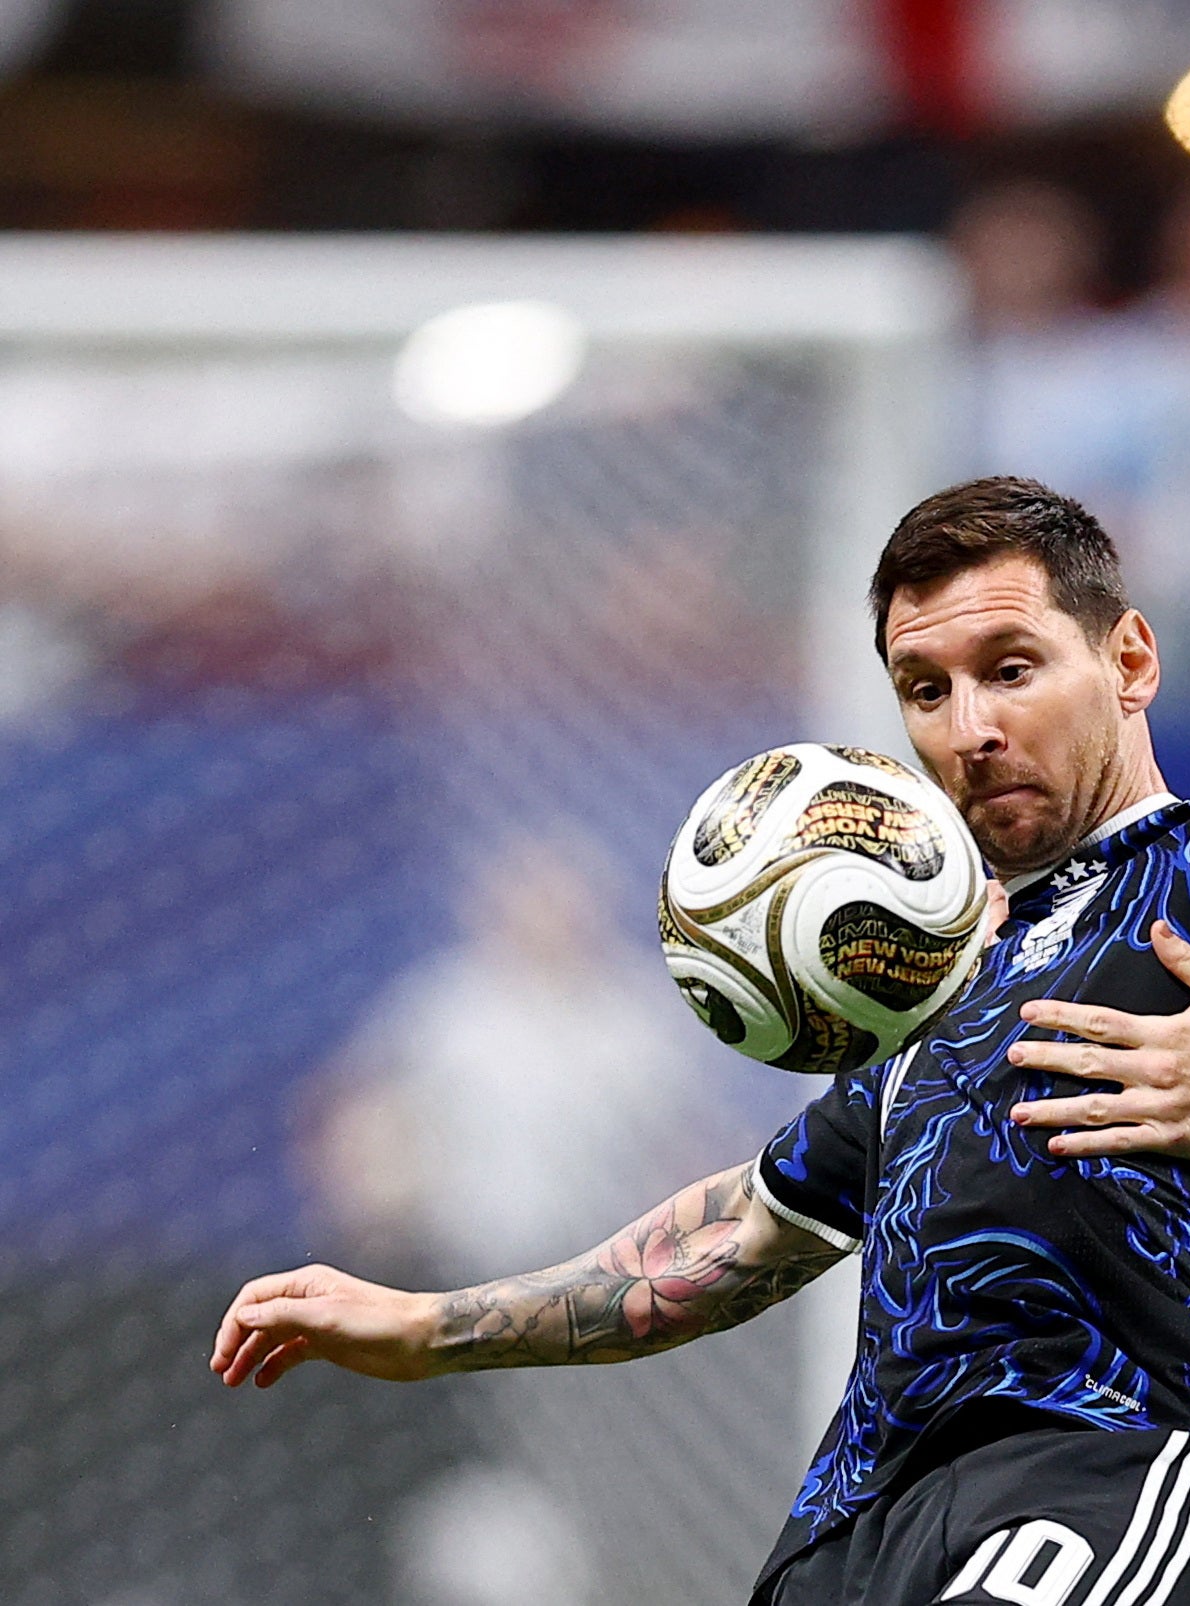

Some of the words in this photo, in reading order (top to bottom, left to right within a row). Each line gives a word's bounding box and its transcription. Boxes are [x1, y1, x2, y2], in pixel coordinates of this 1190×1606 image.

[803, 818, 875, 846] YORK
[838, 939, 897, 962] NEW
[901, 946, 955, 968] YORK
[837, 957, 886, 980] NEW
[939, 1519, 1095, 1606] 10
